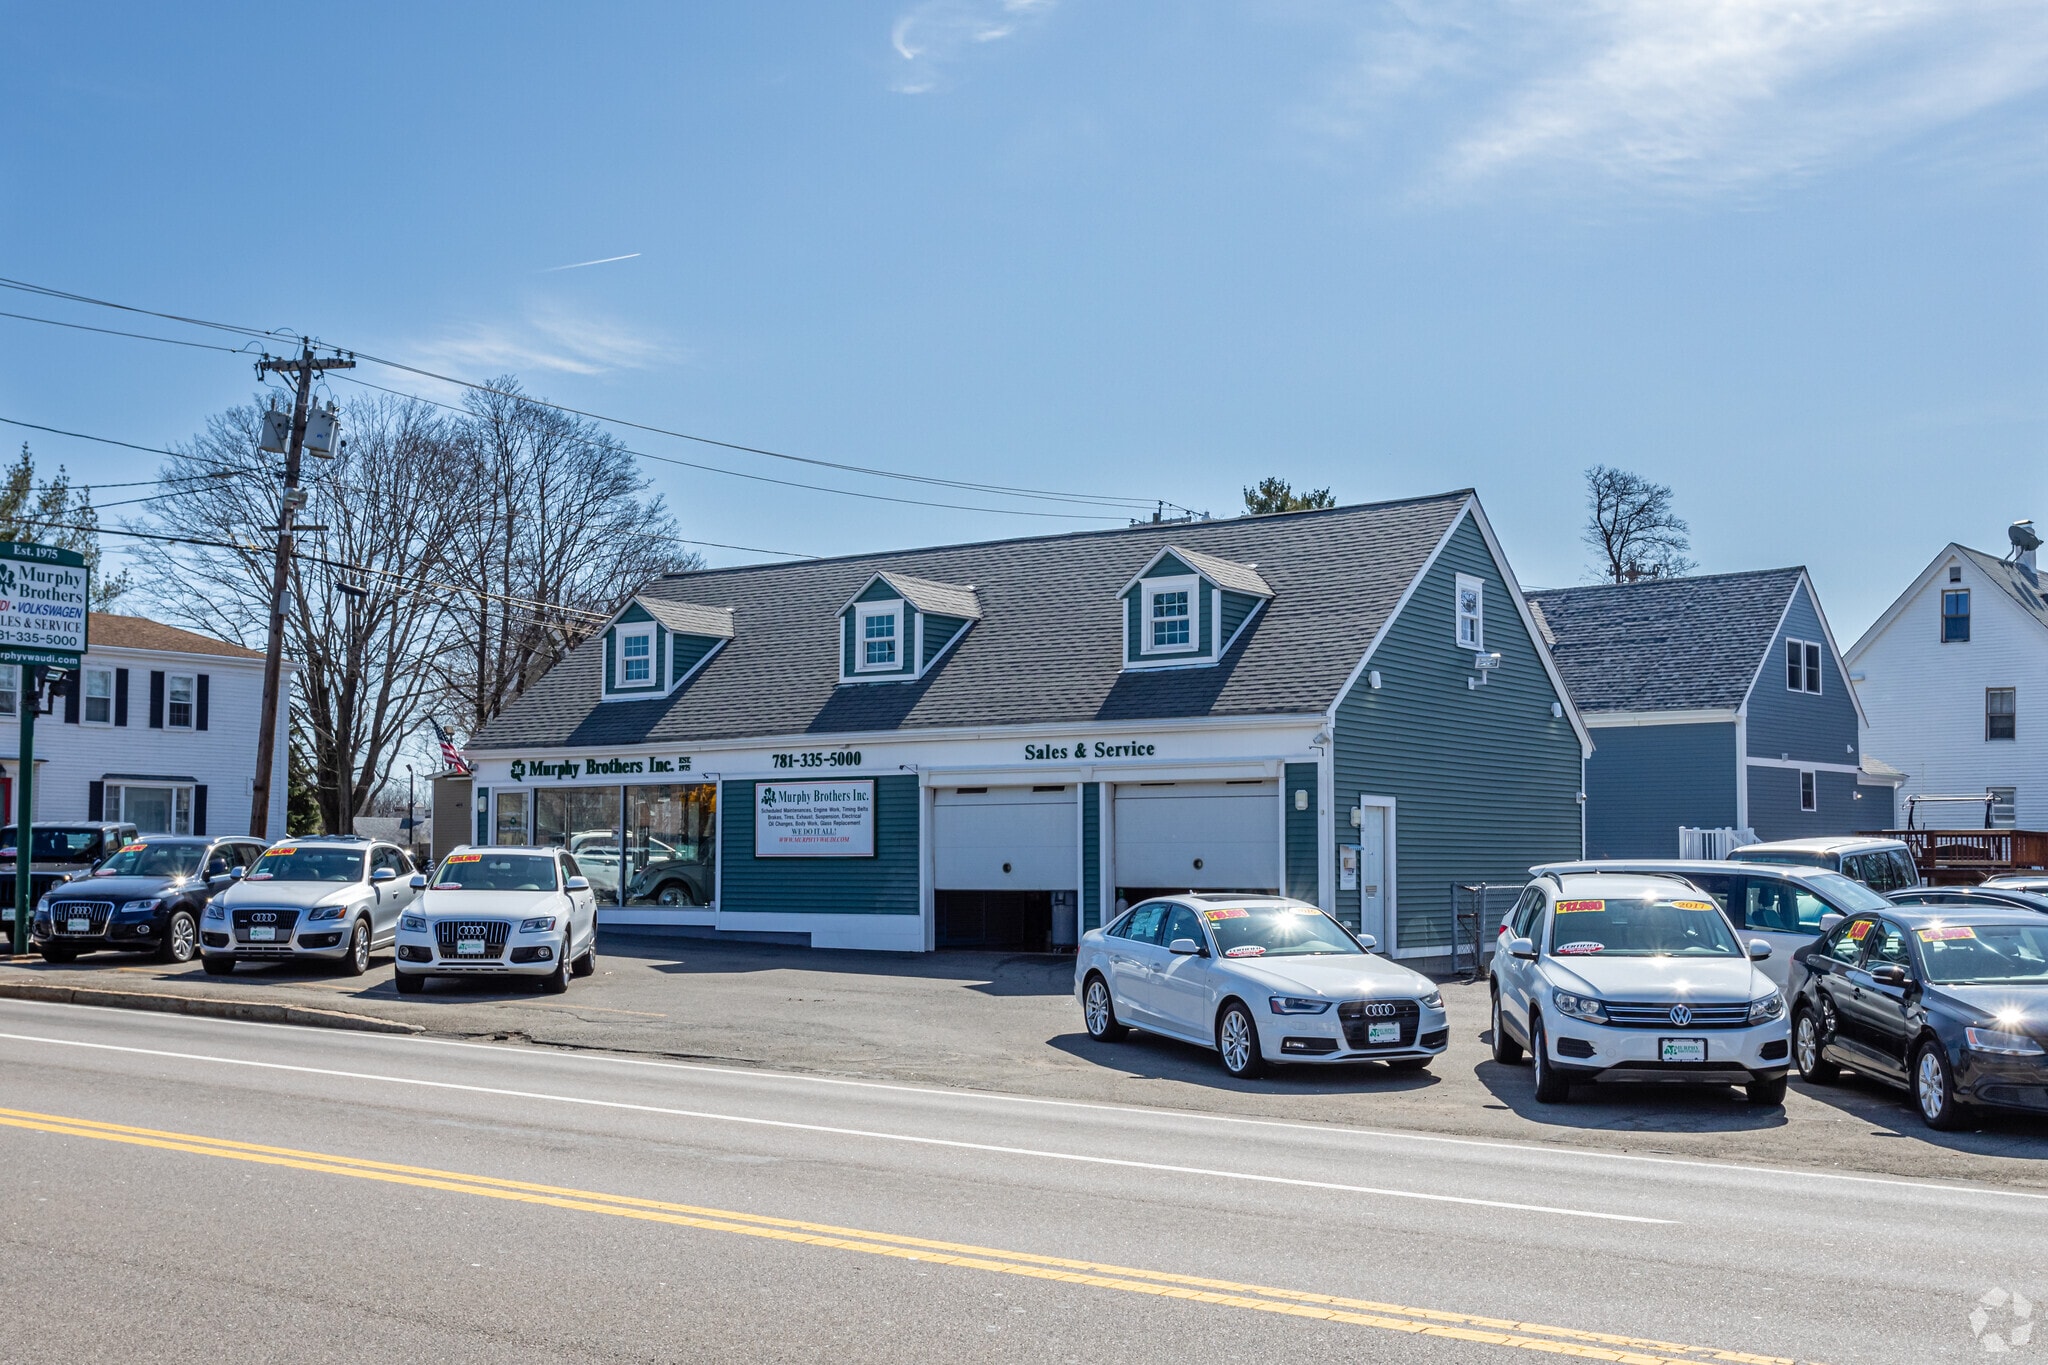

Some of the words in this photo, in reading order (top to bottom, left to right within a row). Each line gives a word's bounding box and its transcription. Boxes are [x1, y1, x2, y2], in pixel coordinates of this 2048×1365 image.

[13, 544, 34, 557] Est.
[36, 547, 58, 559] 1975
[18, 565, 82, 589] Murphy
[19, 583, 83, 604] Brothers
[17, 601, 83, 619] VOLKSWAGEN
[1, 615, 21, 628] LES
[24, 617, 31, 629] &
[34, 618, 82, 634] SERVICE
[772, 751, 862, 768] 781-335-5000
[1025, 743, 1068, 760] Sales
[1074, 742, 1086, 758] &
[1094, 741, 1155, 758] Service
[529, 760, 580, 780] Murphy
[585, 758, 643, 775] Brothers
[648, 756, 675, 772] Inc.
[778, 790, 811, 805] Murphy
[814, 789, 851, 802] Brothers
[853, 788, 869, 801] Inc.
